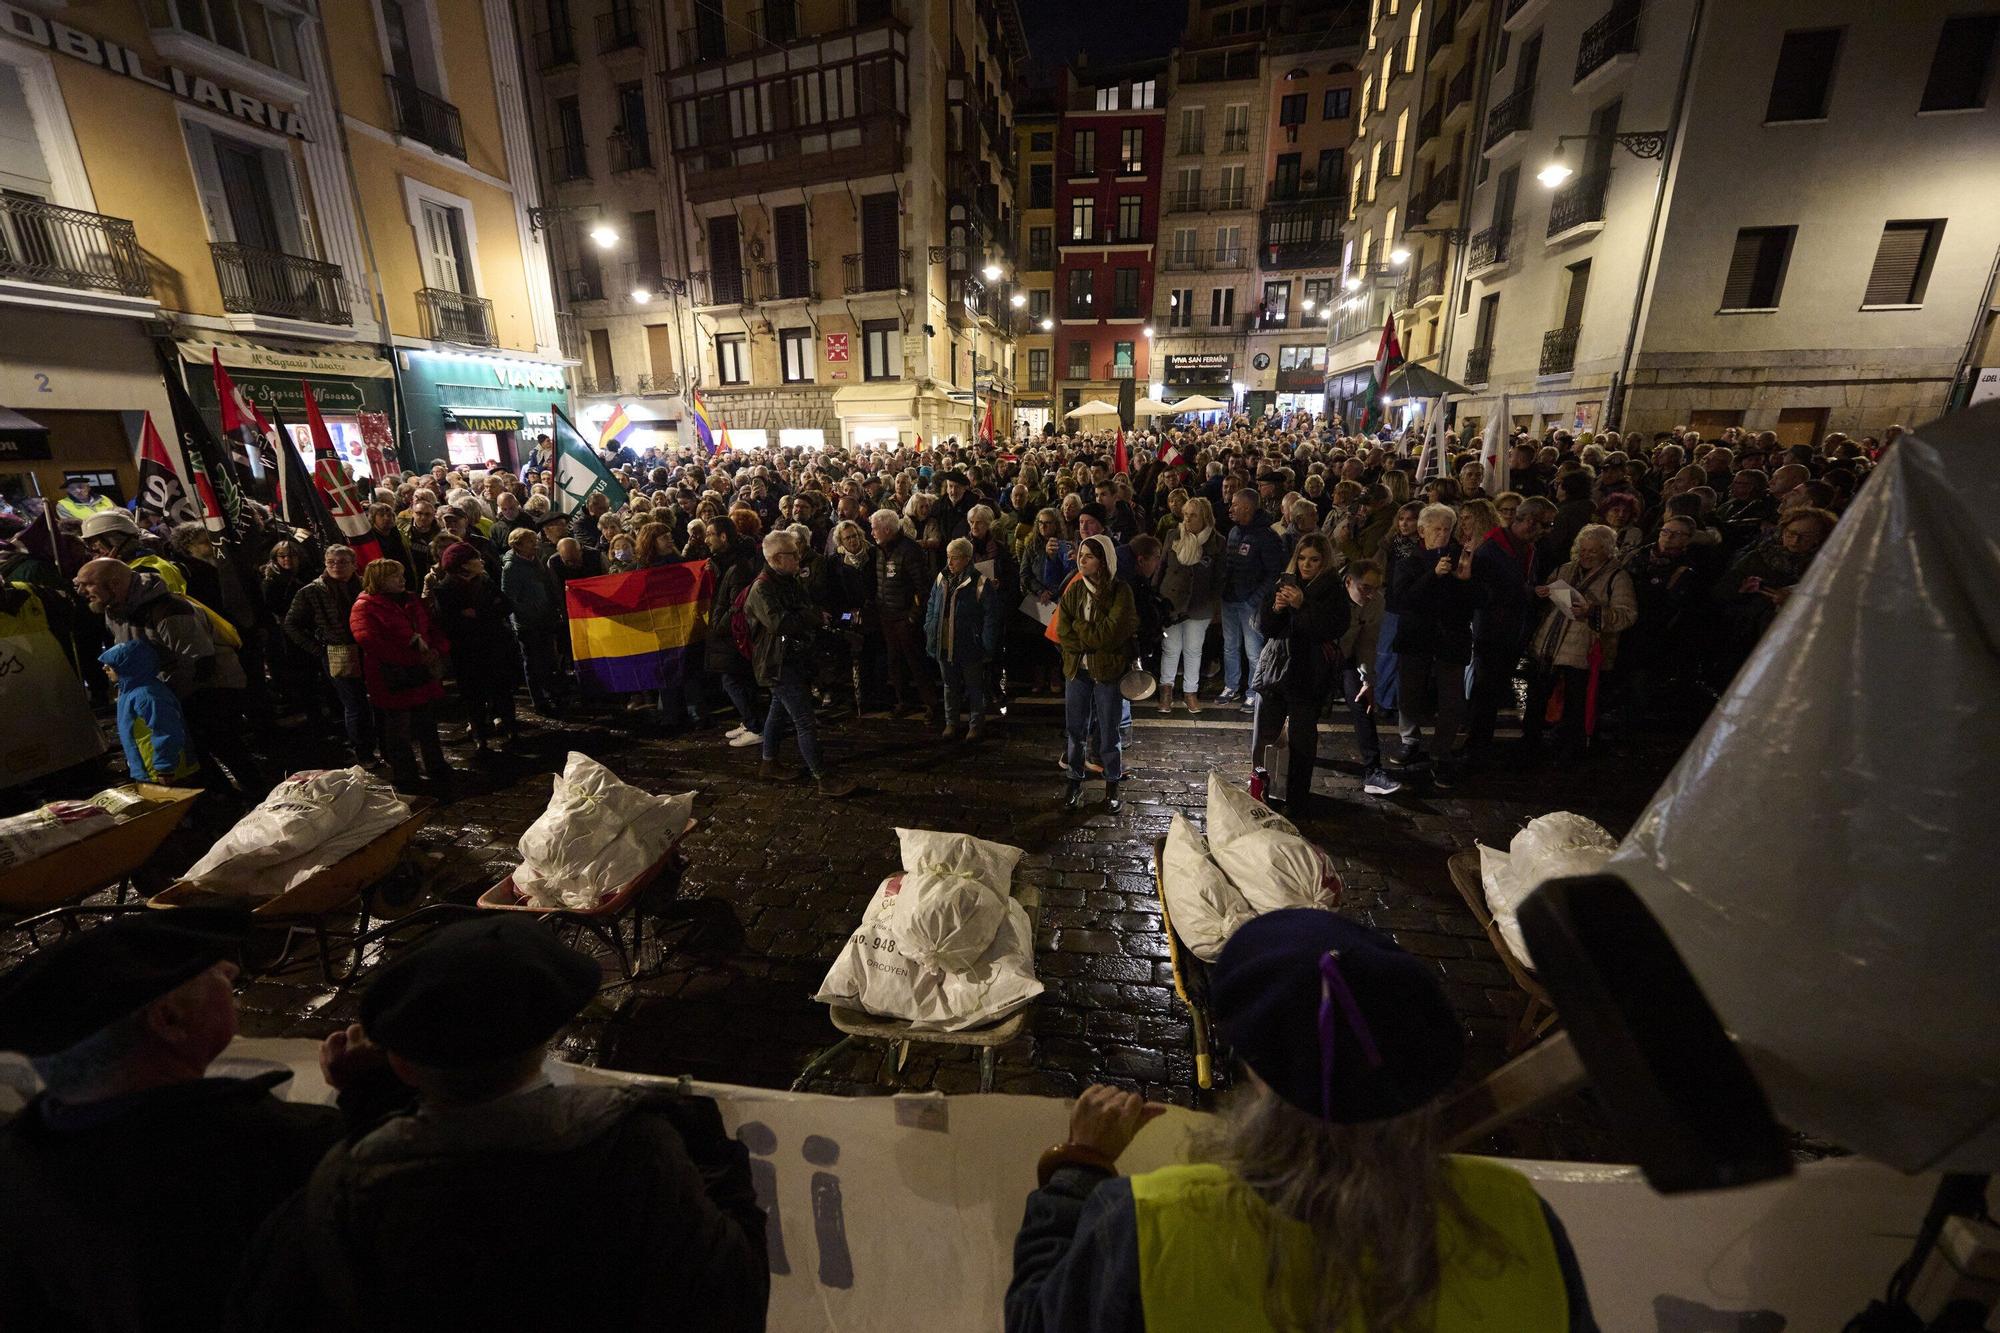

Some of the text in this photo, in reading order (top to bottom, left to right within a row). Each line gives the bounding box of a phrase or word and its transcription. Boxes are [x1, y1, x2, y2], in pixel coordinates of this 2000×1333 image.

[1188, 355, 1201, 363] SAN
[34, 373, 52, 393] 2
[494, 366, 566, 393] VIANDAS
[464, 418, 519, 431] VIANDAS
[525, 412, 546, 426] WE
[872, 937, 896, 953] 948
